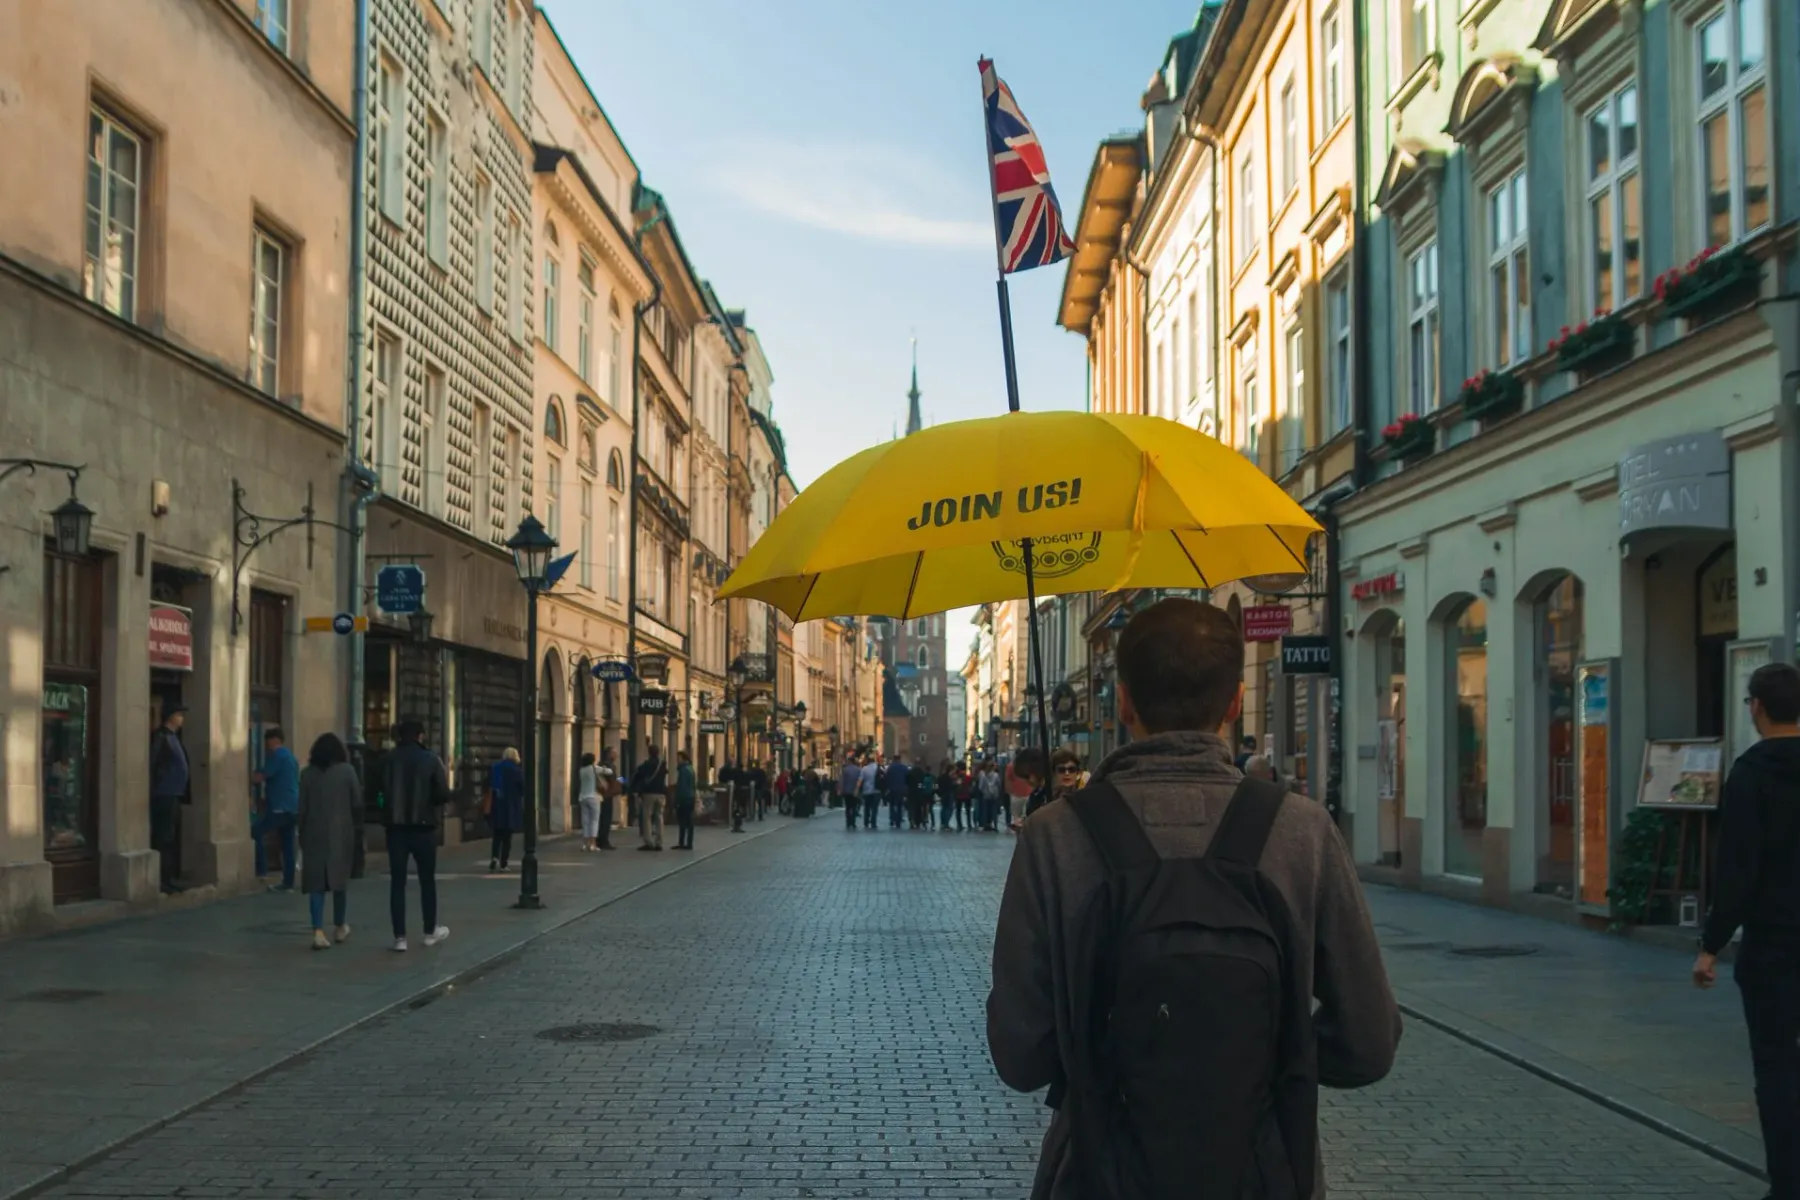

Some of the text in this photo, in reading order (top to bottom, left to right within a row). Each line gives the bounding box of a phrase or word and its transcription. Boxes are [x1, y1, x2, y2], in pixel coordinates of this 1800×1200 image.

[907, 477, 1082, 531] JOIN US!
[641, 698, 664, 709] PUB
